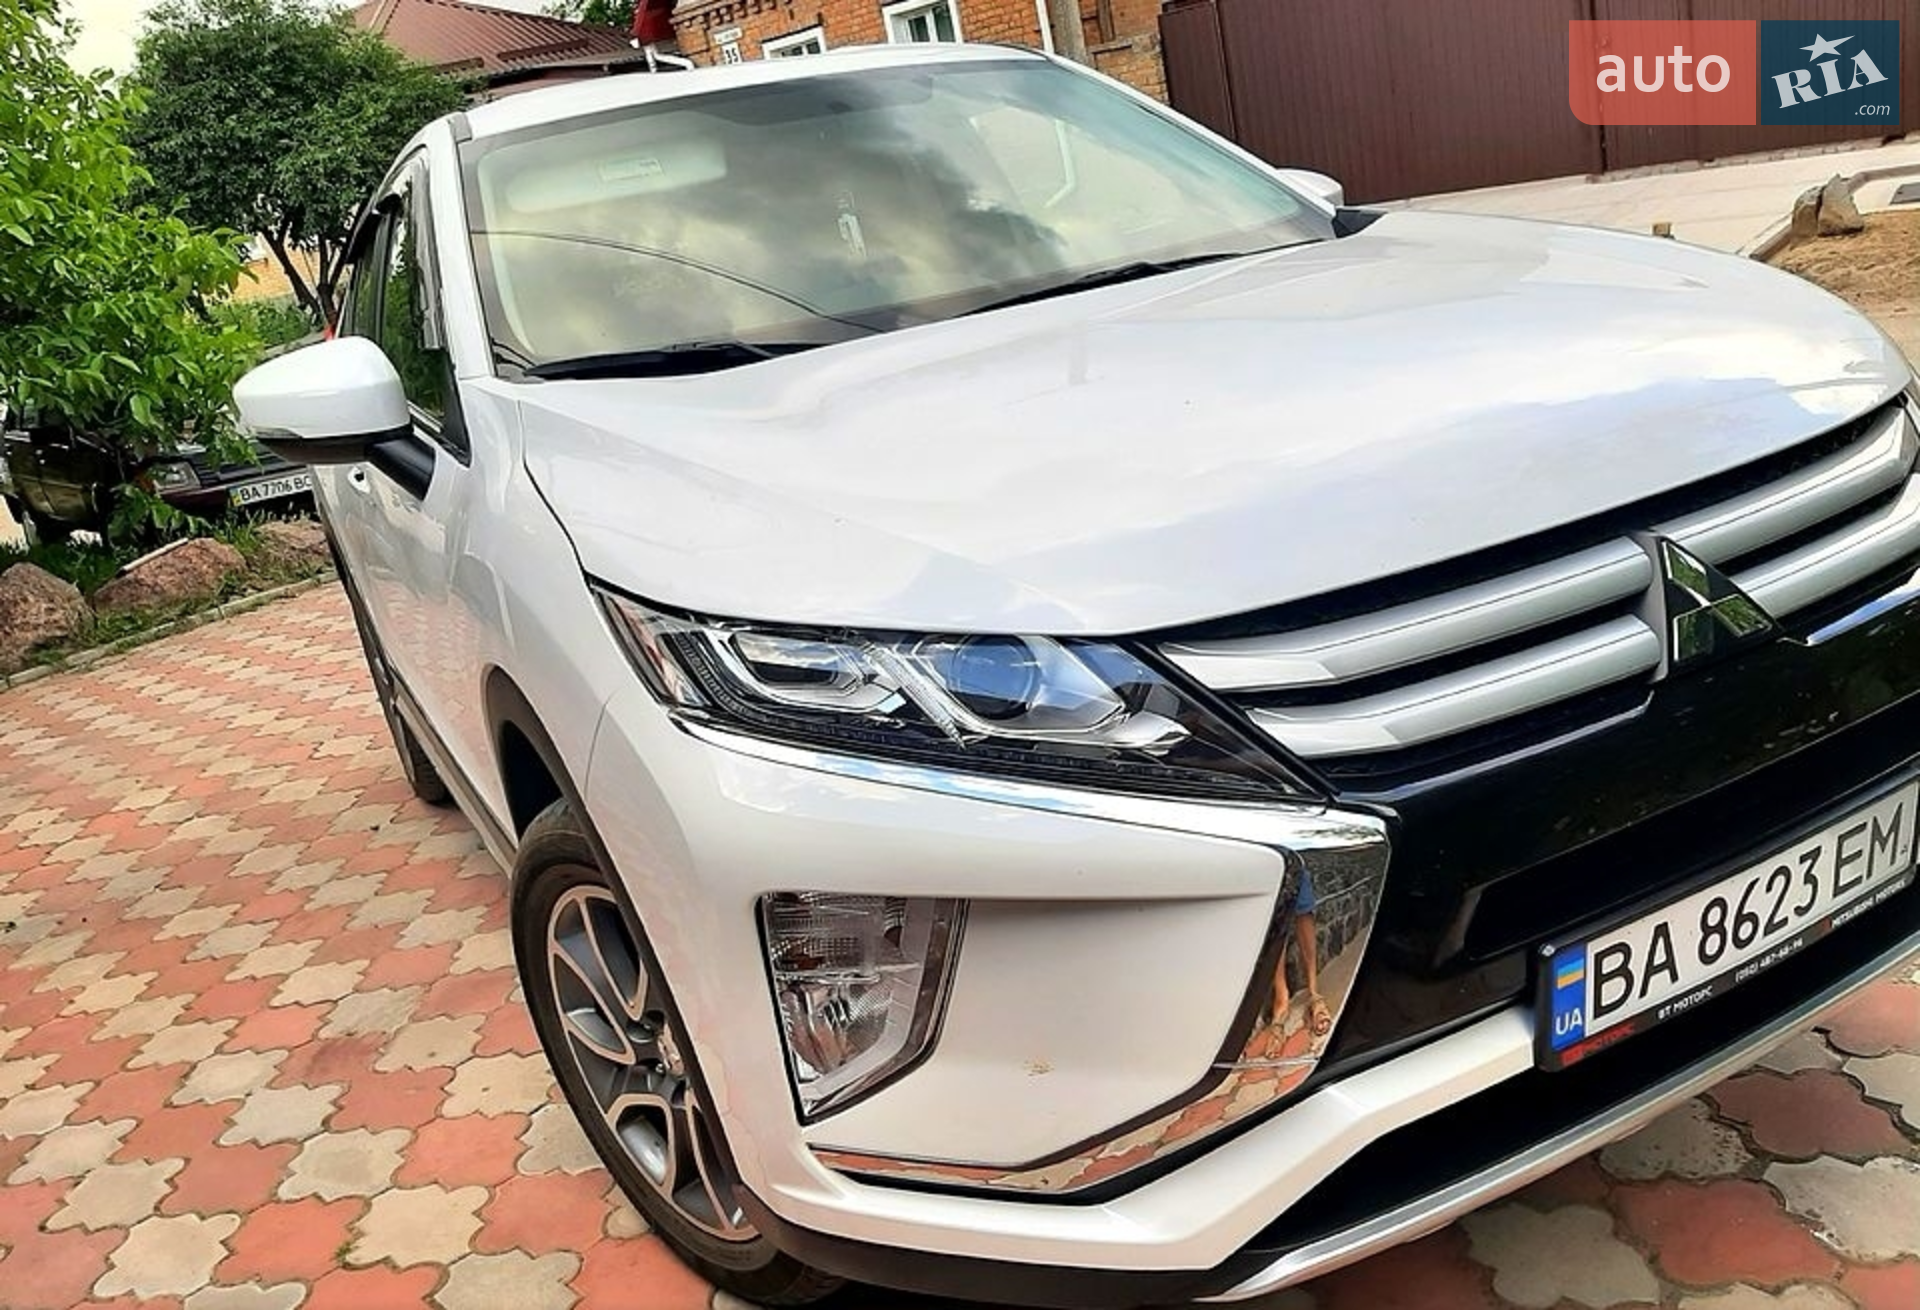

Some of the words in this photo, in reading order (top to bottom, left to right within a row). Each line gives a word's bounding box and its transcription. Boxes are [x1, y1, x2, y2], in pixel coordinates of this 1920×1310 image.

[240, 486, 260, 501] BA
[1593, 921, 1680, 1021] BA
[1697, 846, 1822, 966] 8623
[1832, 802, 1903, 898] EM
[1555, 1007, 1583, 1036] UA
